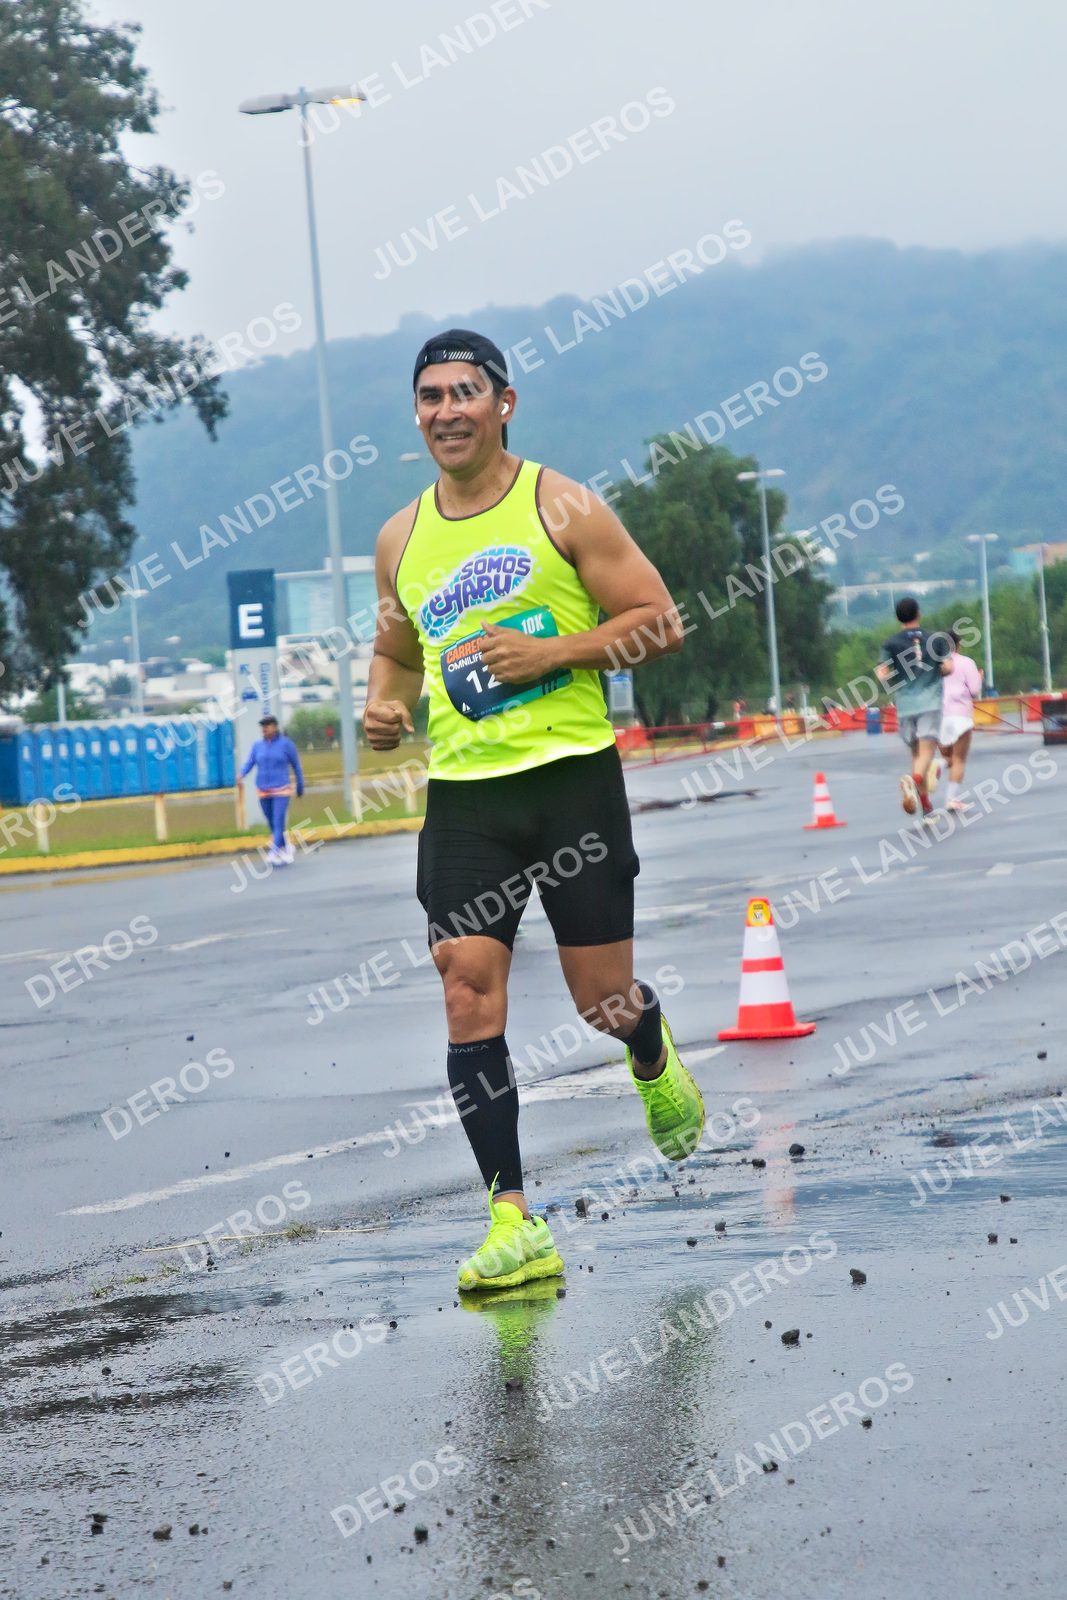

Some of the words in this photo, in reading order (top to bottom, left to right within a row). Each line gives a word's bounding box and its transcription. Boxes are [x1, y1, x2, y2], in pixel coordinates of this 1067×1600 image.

[460, 556, 531, 580] SOMOS
[429, 574, 512, 616] CHAPU
[238, 602, 265, 639] E
[521, 613, 545, 635] 10K
[447, 634, 488, 664] CARRE
